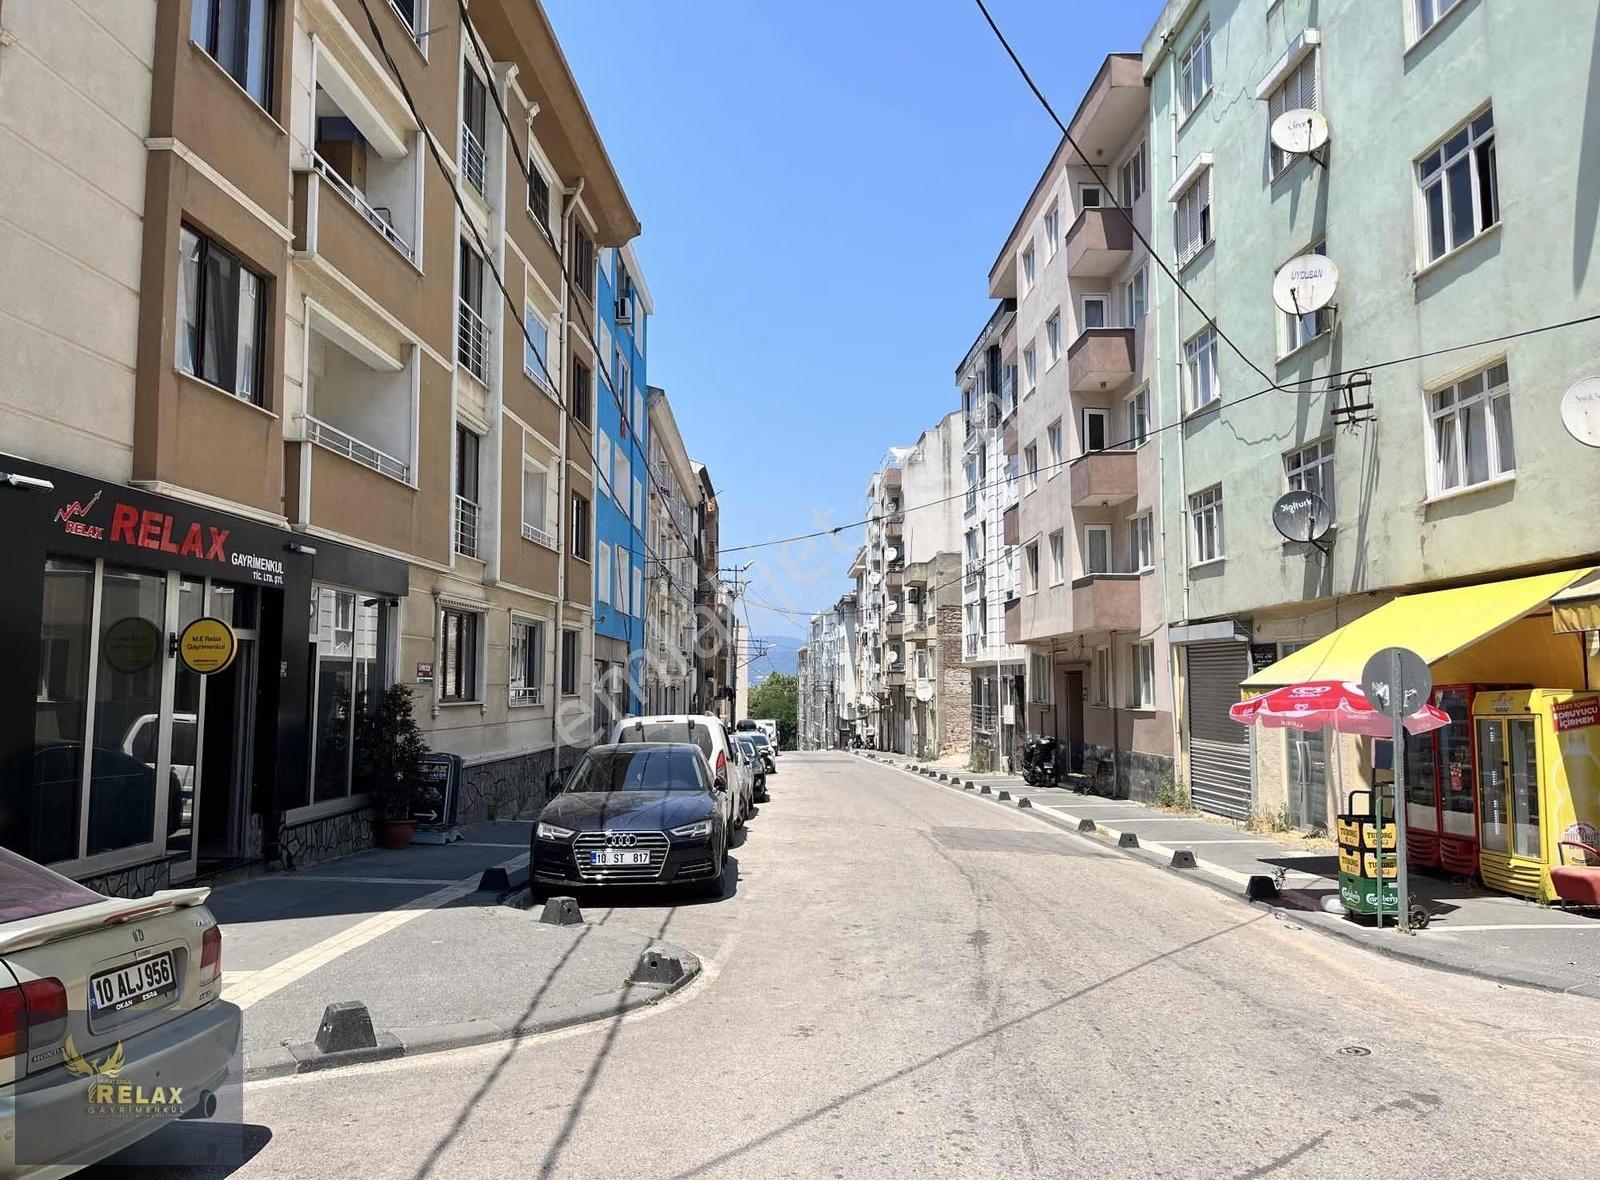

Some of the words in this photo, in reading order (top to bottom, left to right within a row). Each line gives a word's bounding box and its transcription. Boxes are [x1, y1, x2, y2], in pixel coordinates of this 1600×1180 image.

[65, 520, 104, 540] RELAX
[109, 502, 230, 563] RELAX
[231, 552, 284, 575] GAYRİMENKUL
[597, 853, 607, 864] 10
[614, 853, 625, 863] ST
[633, 853, 649, 863] 817
[96, 977, 114, 1005] 10
[118, 967, 144, 999] ALJ
[145, 958, 170, 988] 956
[115, 999, 133, 1011] OKAN
